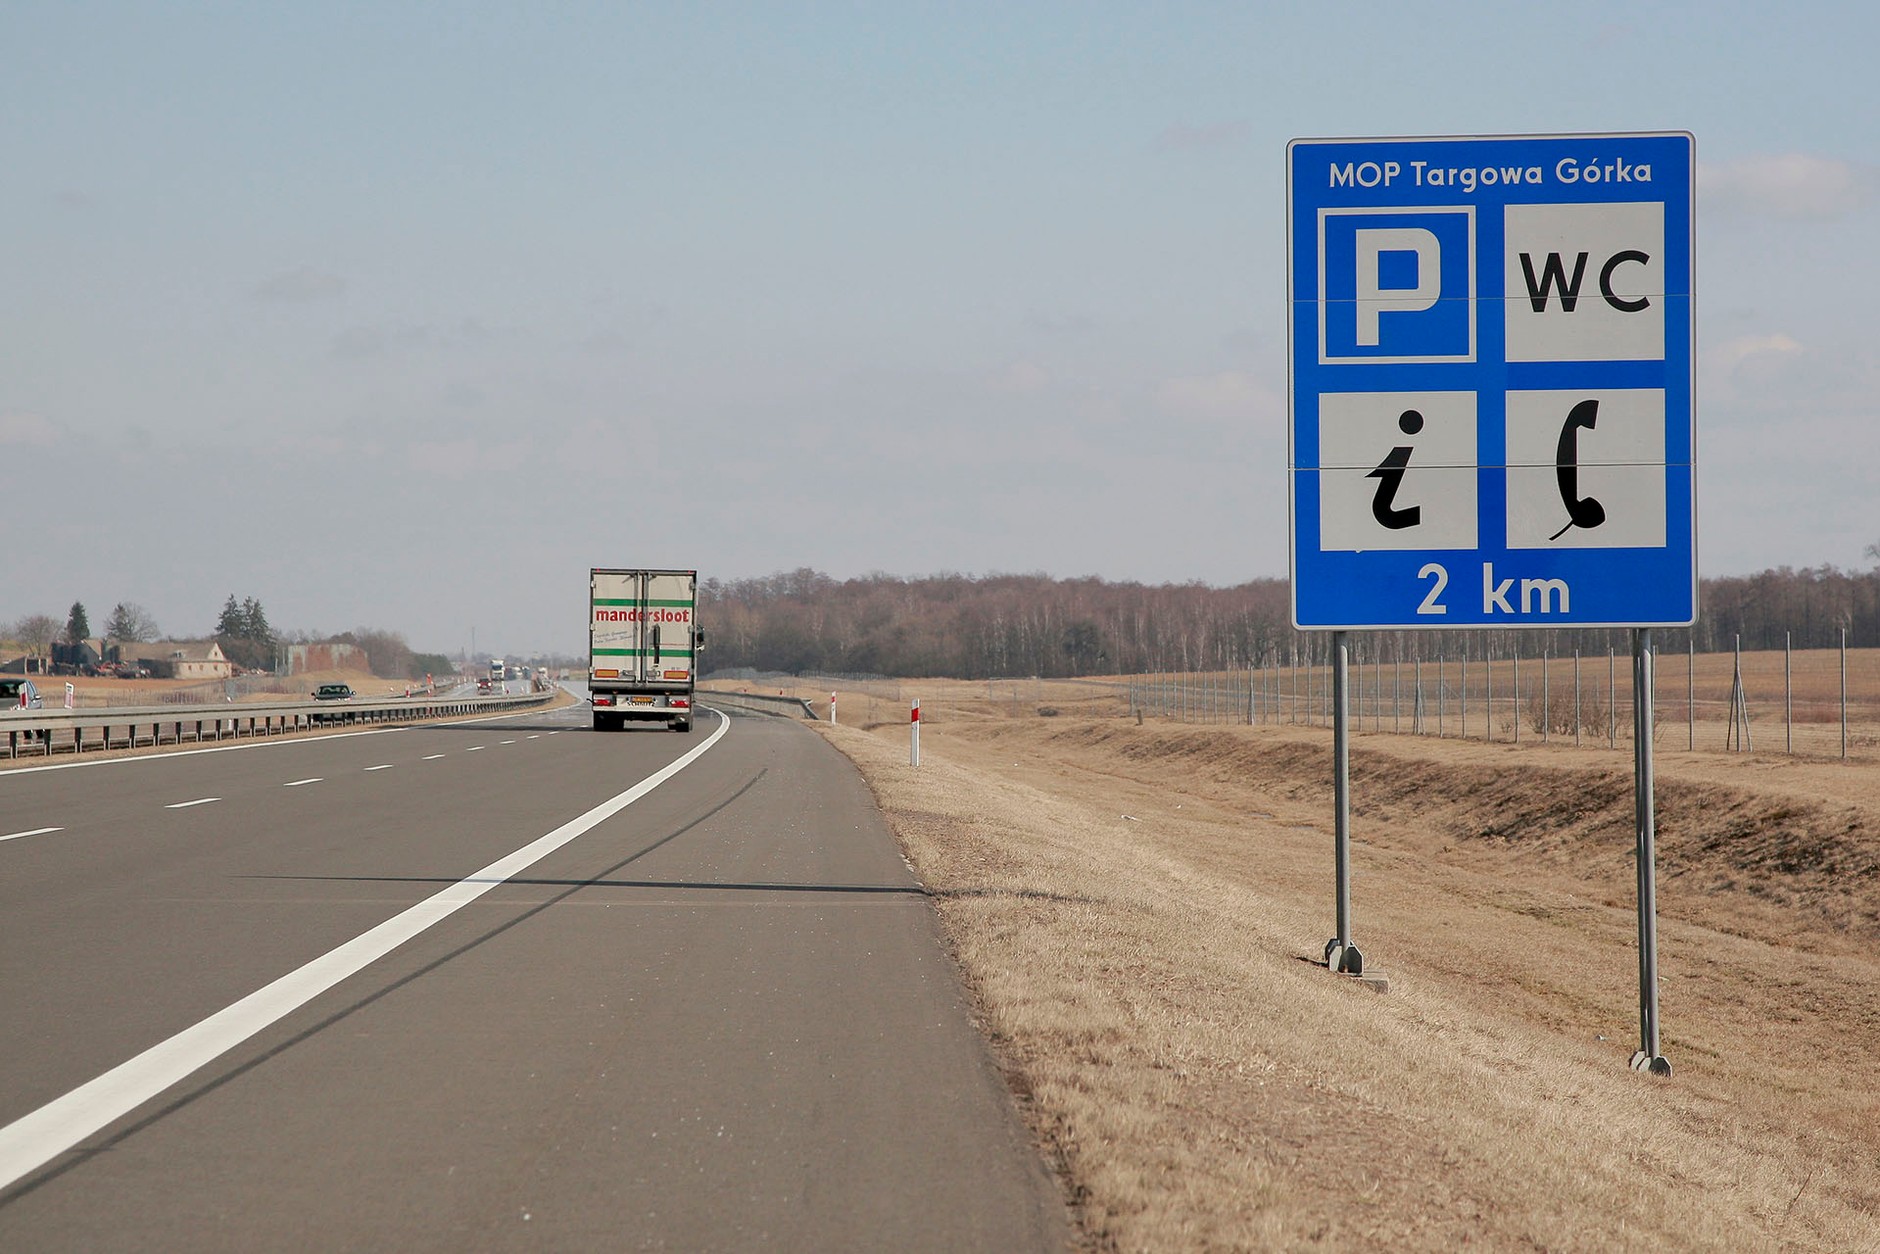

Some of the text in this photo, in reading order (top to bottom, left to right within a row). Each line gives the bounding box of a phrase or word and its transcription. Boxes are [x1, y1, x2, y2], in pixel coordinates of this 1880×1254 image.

[1329, 157, 1653, 193] MOP Targowa Górka
[1355, 227, 1441, 346] P
[1518, 250, 1651, 313] WC
[1416, 562, 1571, 615] 2 km
[596, 608, 690, 623] mandersloot
